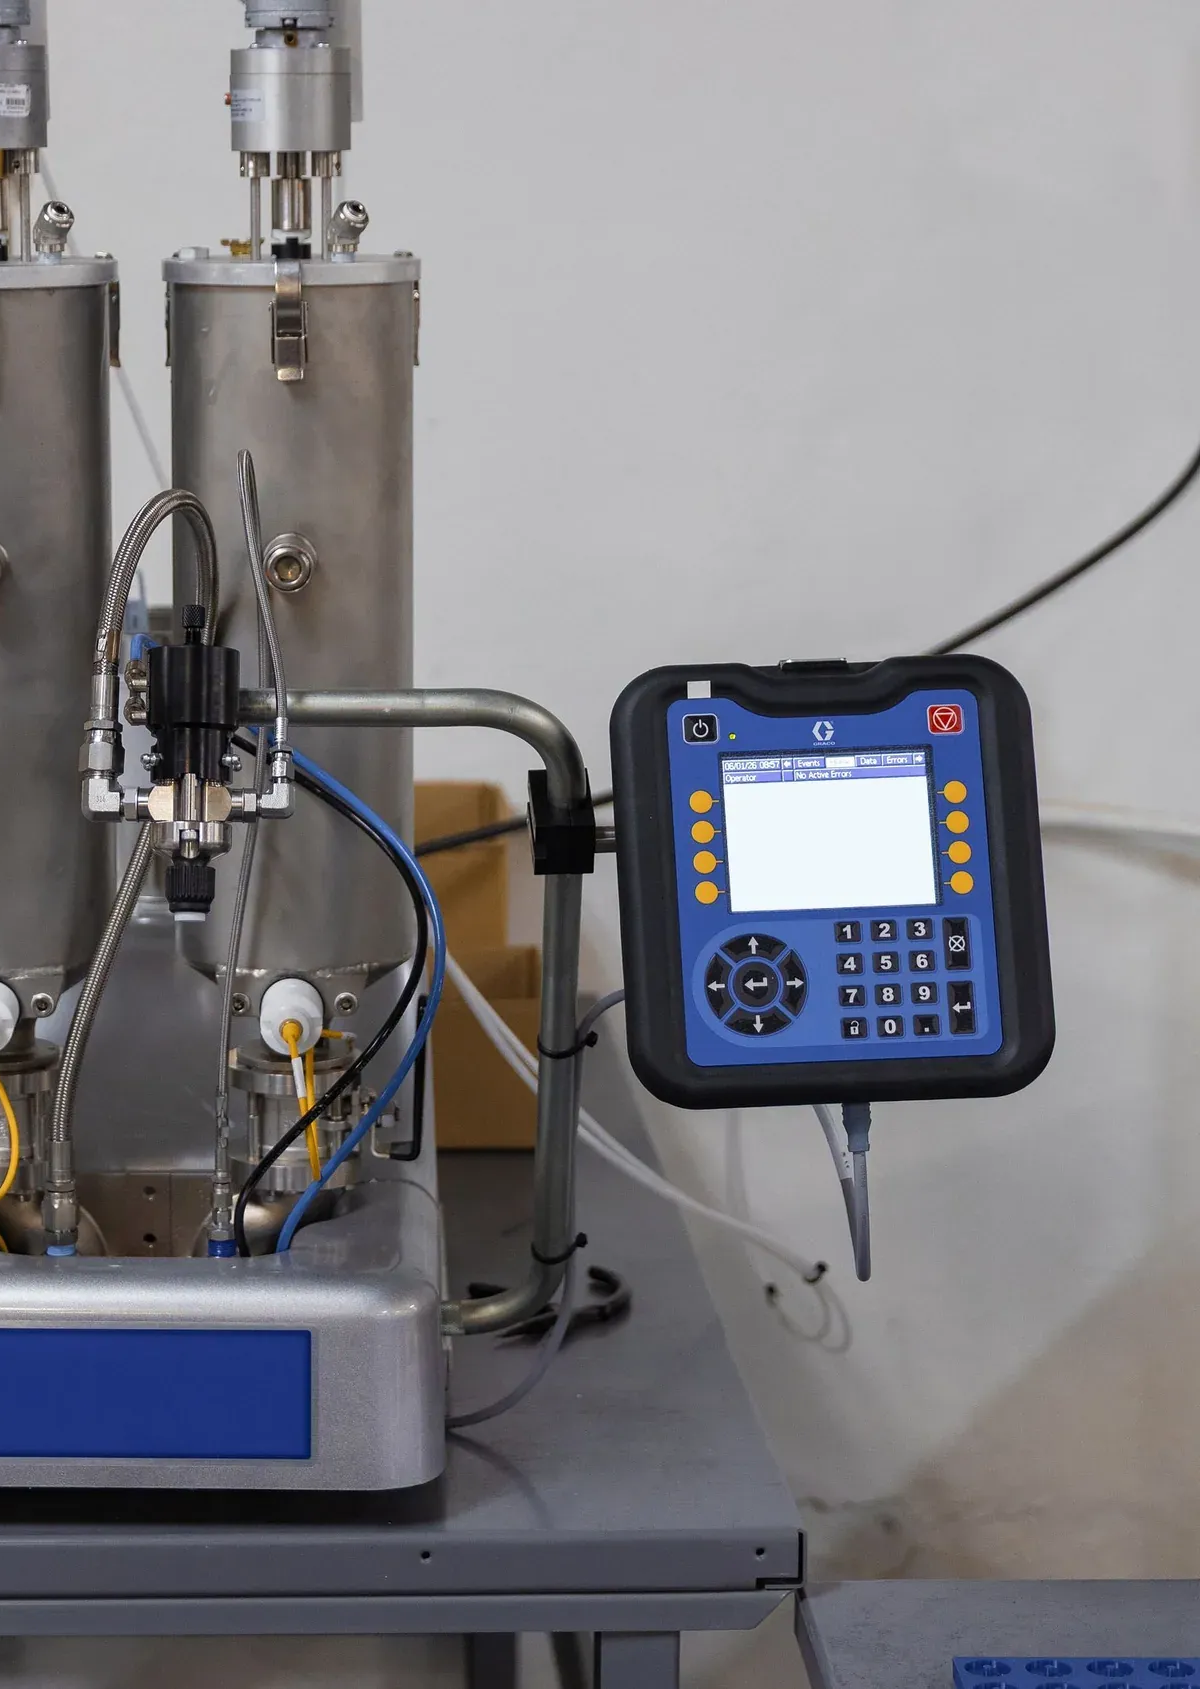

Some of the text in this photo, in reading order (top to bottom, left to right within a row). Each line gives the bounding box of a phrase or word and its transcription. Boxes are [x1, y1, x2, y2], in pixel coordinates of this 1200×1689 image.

[860, 757, 877, 765] Data
[886, 756, 908, 764] Errors
[725, 774, 757, 784] Operator
[796, 770, 852, 779] No Active Errors
[842, 922, 926, 939] 1 2 3
[843, 954, 928, 971] 4 5 6
[845, 986, 931, 1003] 7 8 9
[884, 1019, 897, 1034] 0
